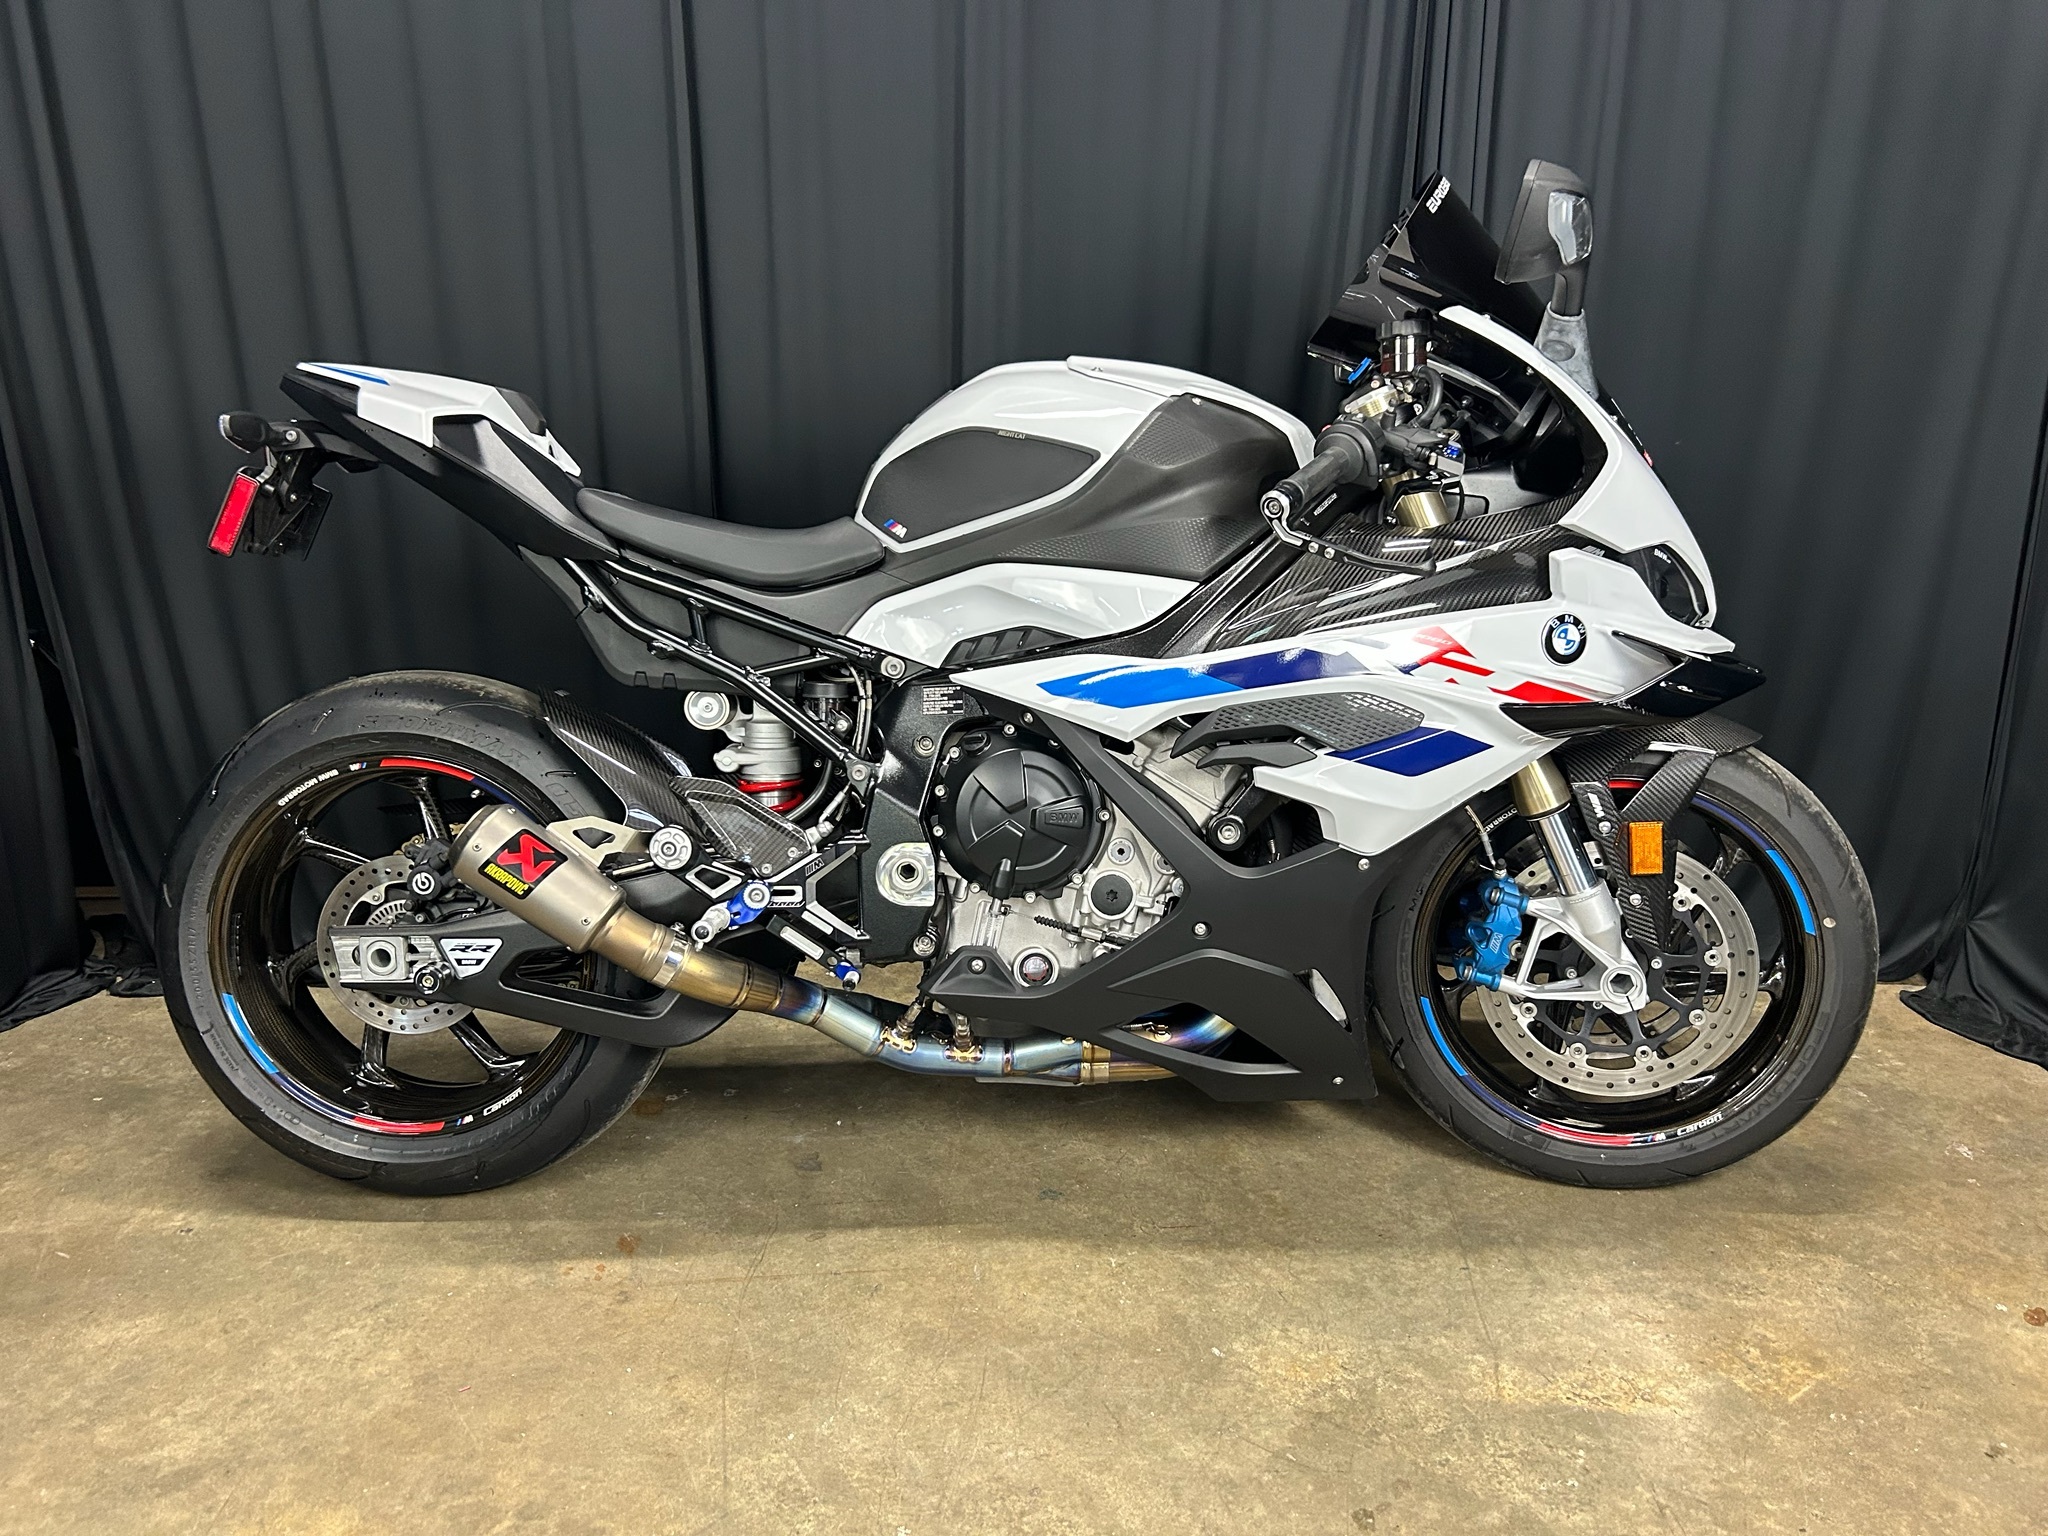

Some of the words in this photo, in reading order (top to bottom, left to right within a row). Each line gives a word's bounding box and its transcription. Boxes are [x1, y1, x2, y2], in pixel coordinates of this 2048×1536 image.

[1015, 432, 1026, 440] CAT
[1549, 614, 1587, 639] BMW
[317, 769, 339, 782] BMW
[278, 777, 319, 807] MOTORRAD
[1050, 812, 1079, 823] BMW
[1485, 807, 1518, 832] OTORRAD
[449, 944, 496, 954] RR
